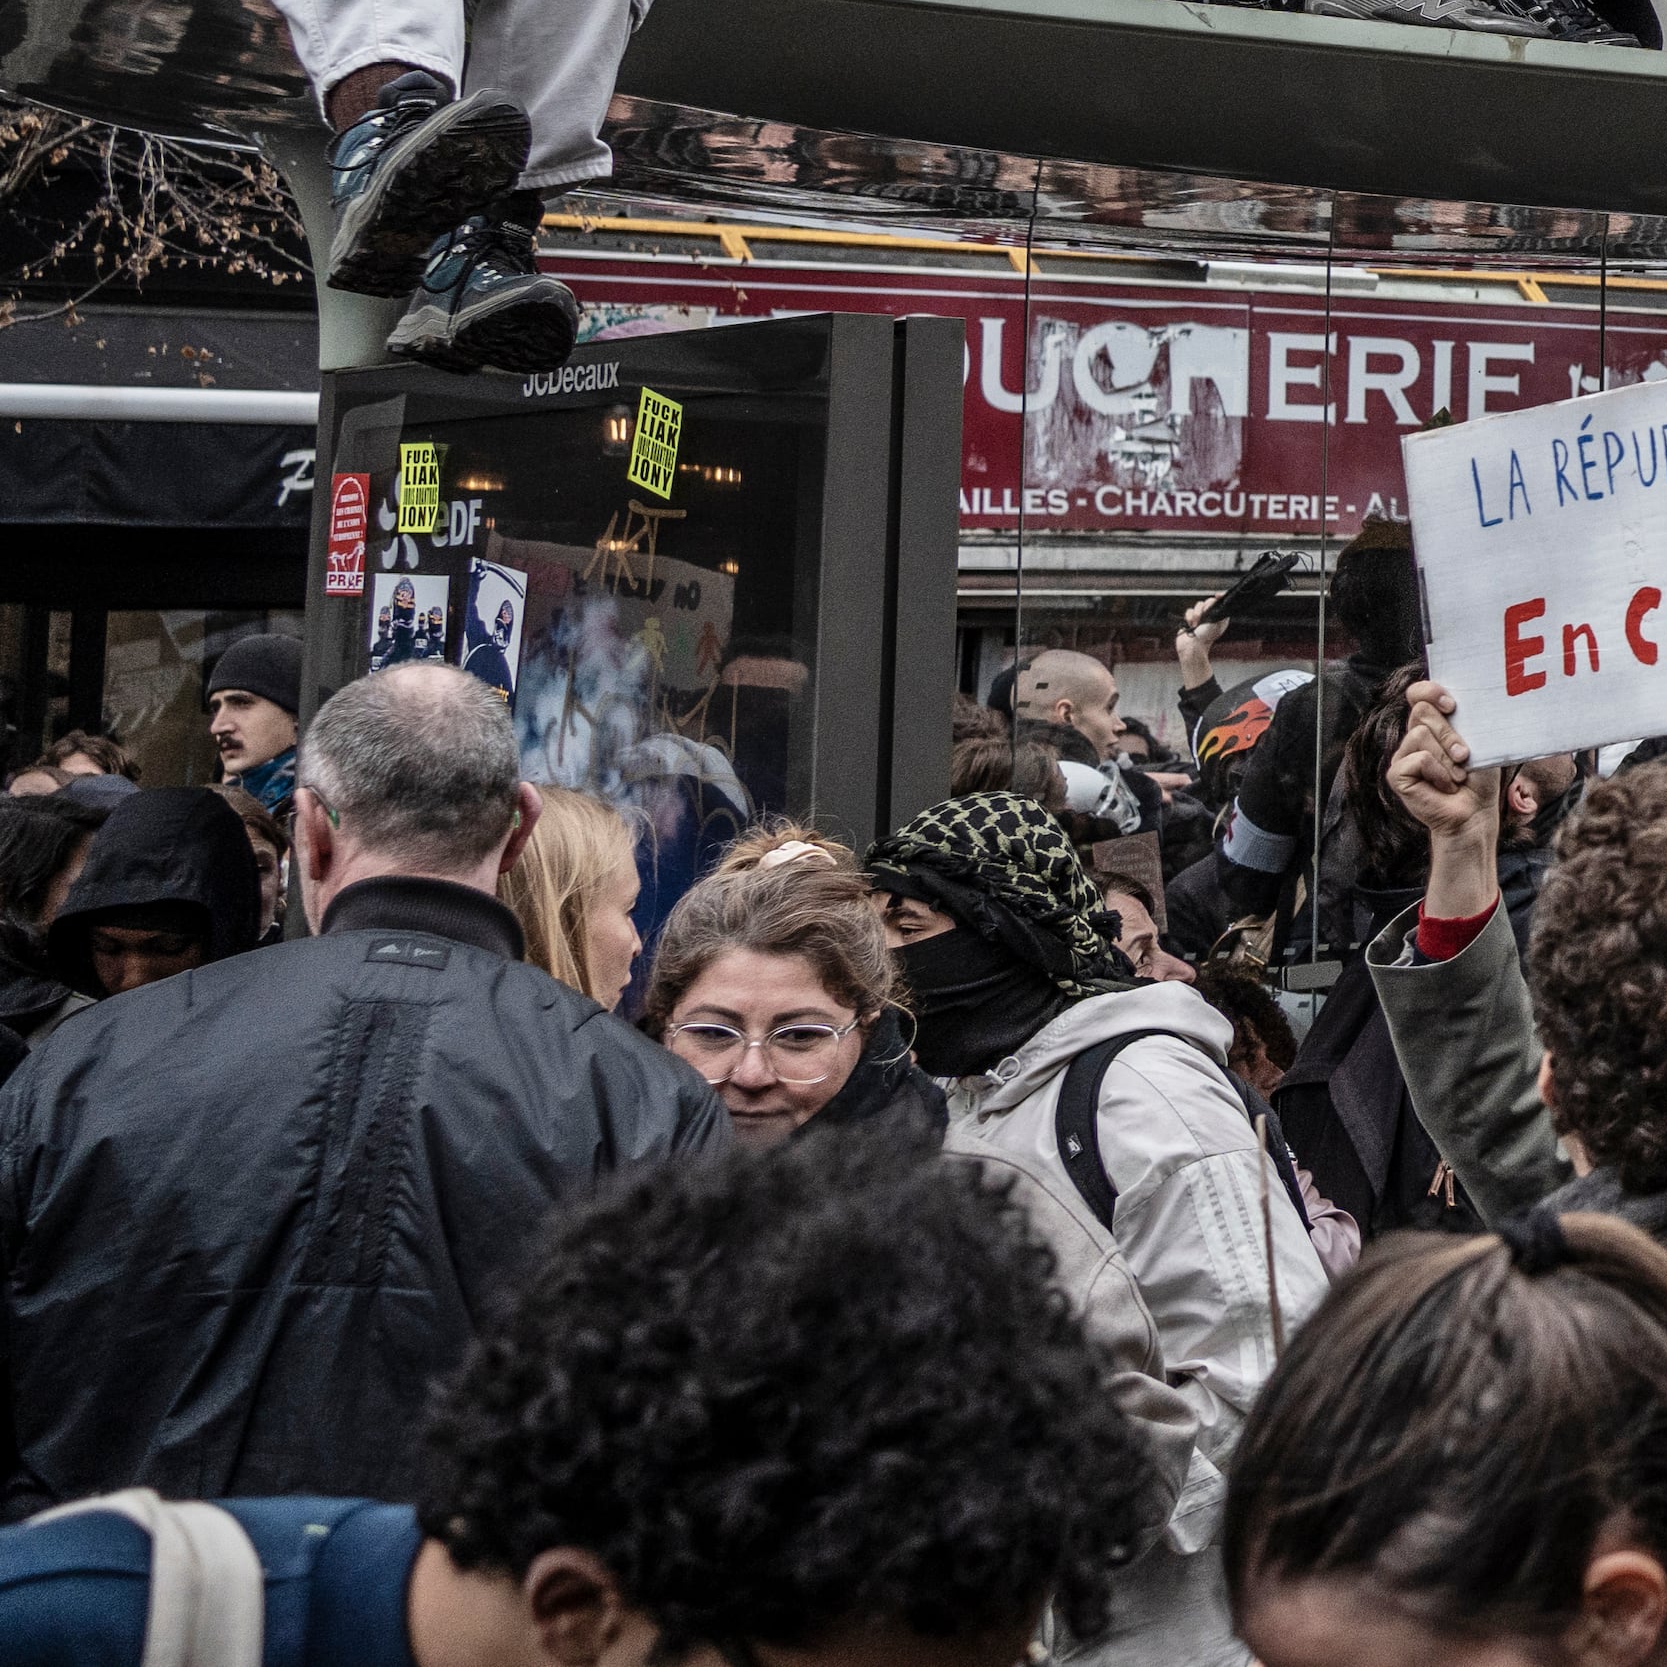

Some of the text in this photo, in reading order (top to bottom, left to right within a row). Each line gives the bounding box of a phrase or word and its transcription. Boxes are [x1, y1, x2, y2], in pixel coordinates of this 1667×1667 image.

[964, 317, 1536, 425] UCHERIE
[644, 396, 680, 426] FUCK
[640, 412, 679, 448] LIAK
[405, 465, 438, 485] LIAK
[631, 454, 671, 492] JONY
[1471, 448, 1532, 527] LA
[401, 506, 437, 527] JONY
[1095, 486, 1340, 523] CHARCUTERIE
[1504, 597, 1600, 696] En
